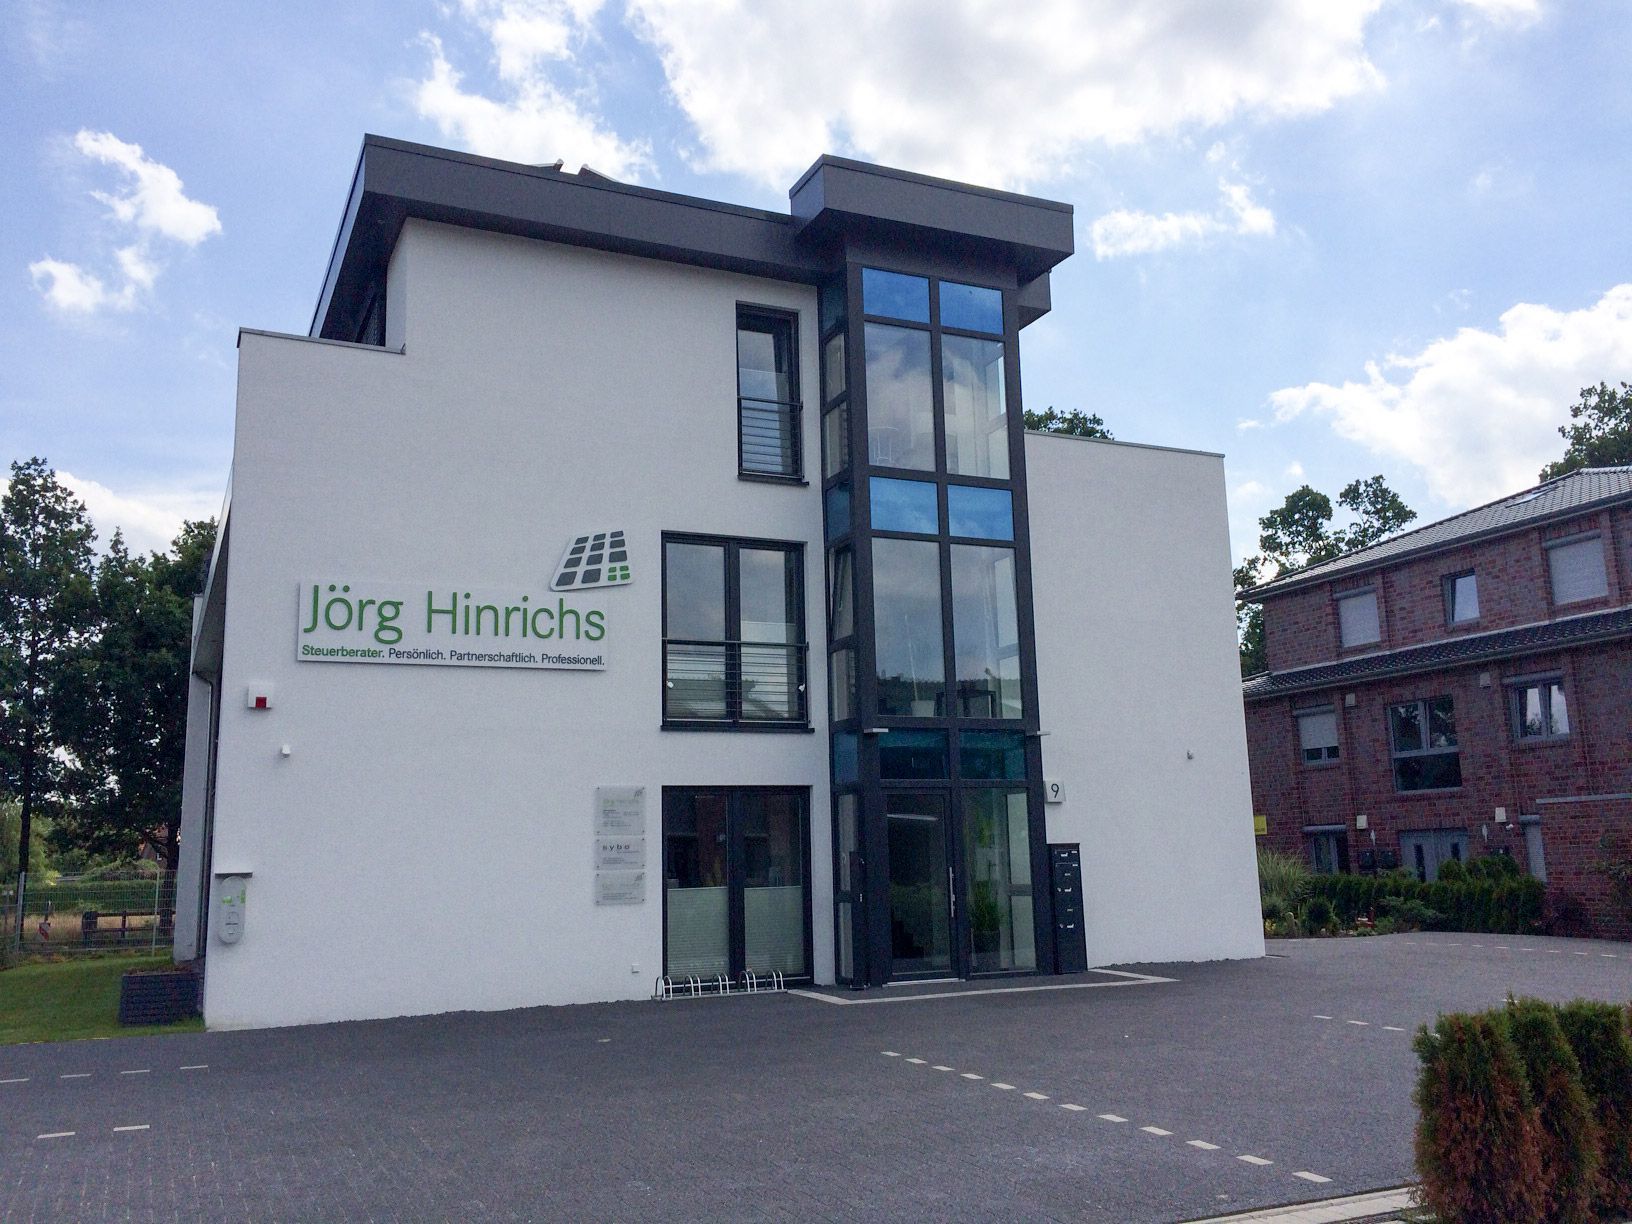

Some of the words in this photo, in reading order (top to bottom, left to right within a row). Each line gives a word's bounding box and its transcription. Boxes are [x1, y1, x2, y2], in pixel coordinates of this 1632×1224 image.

[303, 584, 404, 645] Jörg
[427, 590, 606, 641] Hinrichs
[302, 644, 385, 659] Steuerberater.
[388, 648, 446, 661] Persönlich.
[450, 650, 538, 664] Partnerschaftlich.
[541, 653, 605, 666] Professionell.
[1051, 783, 1060, 799] 9
